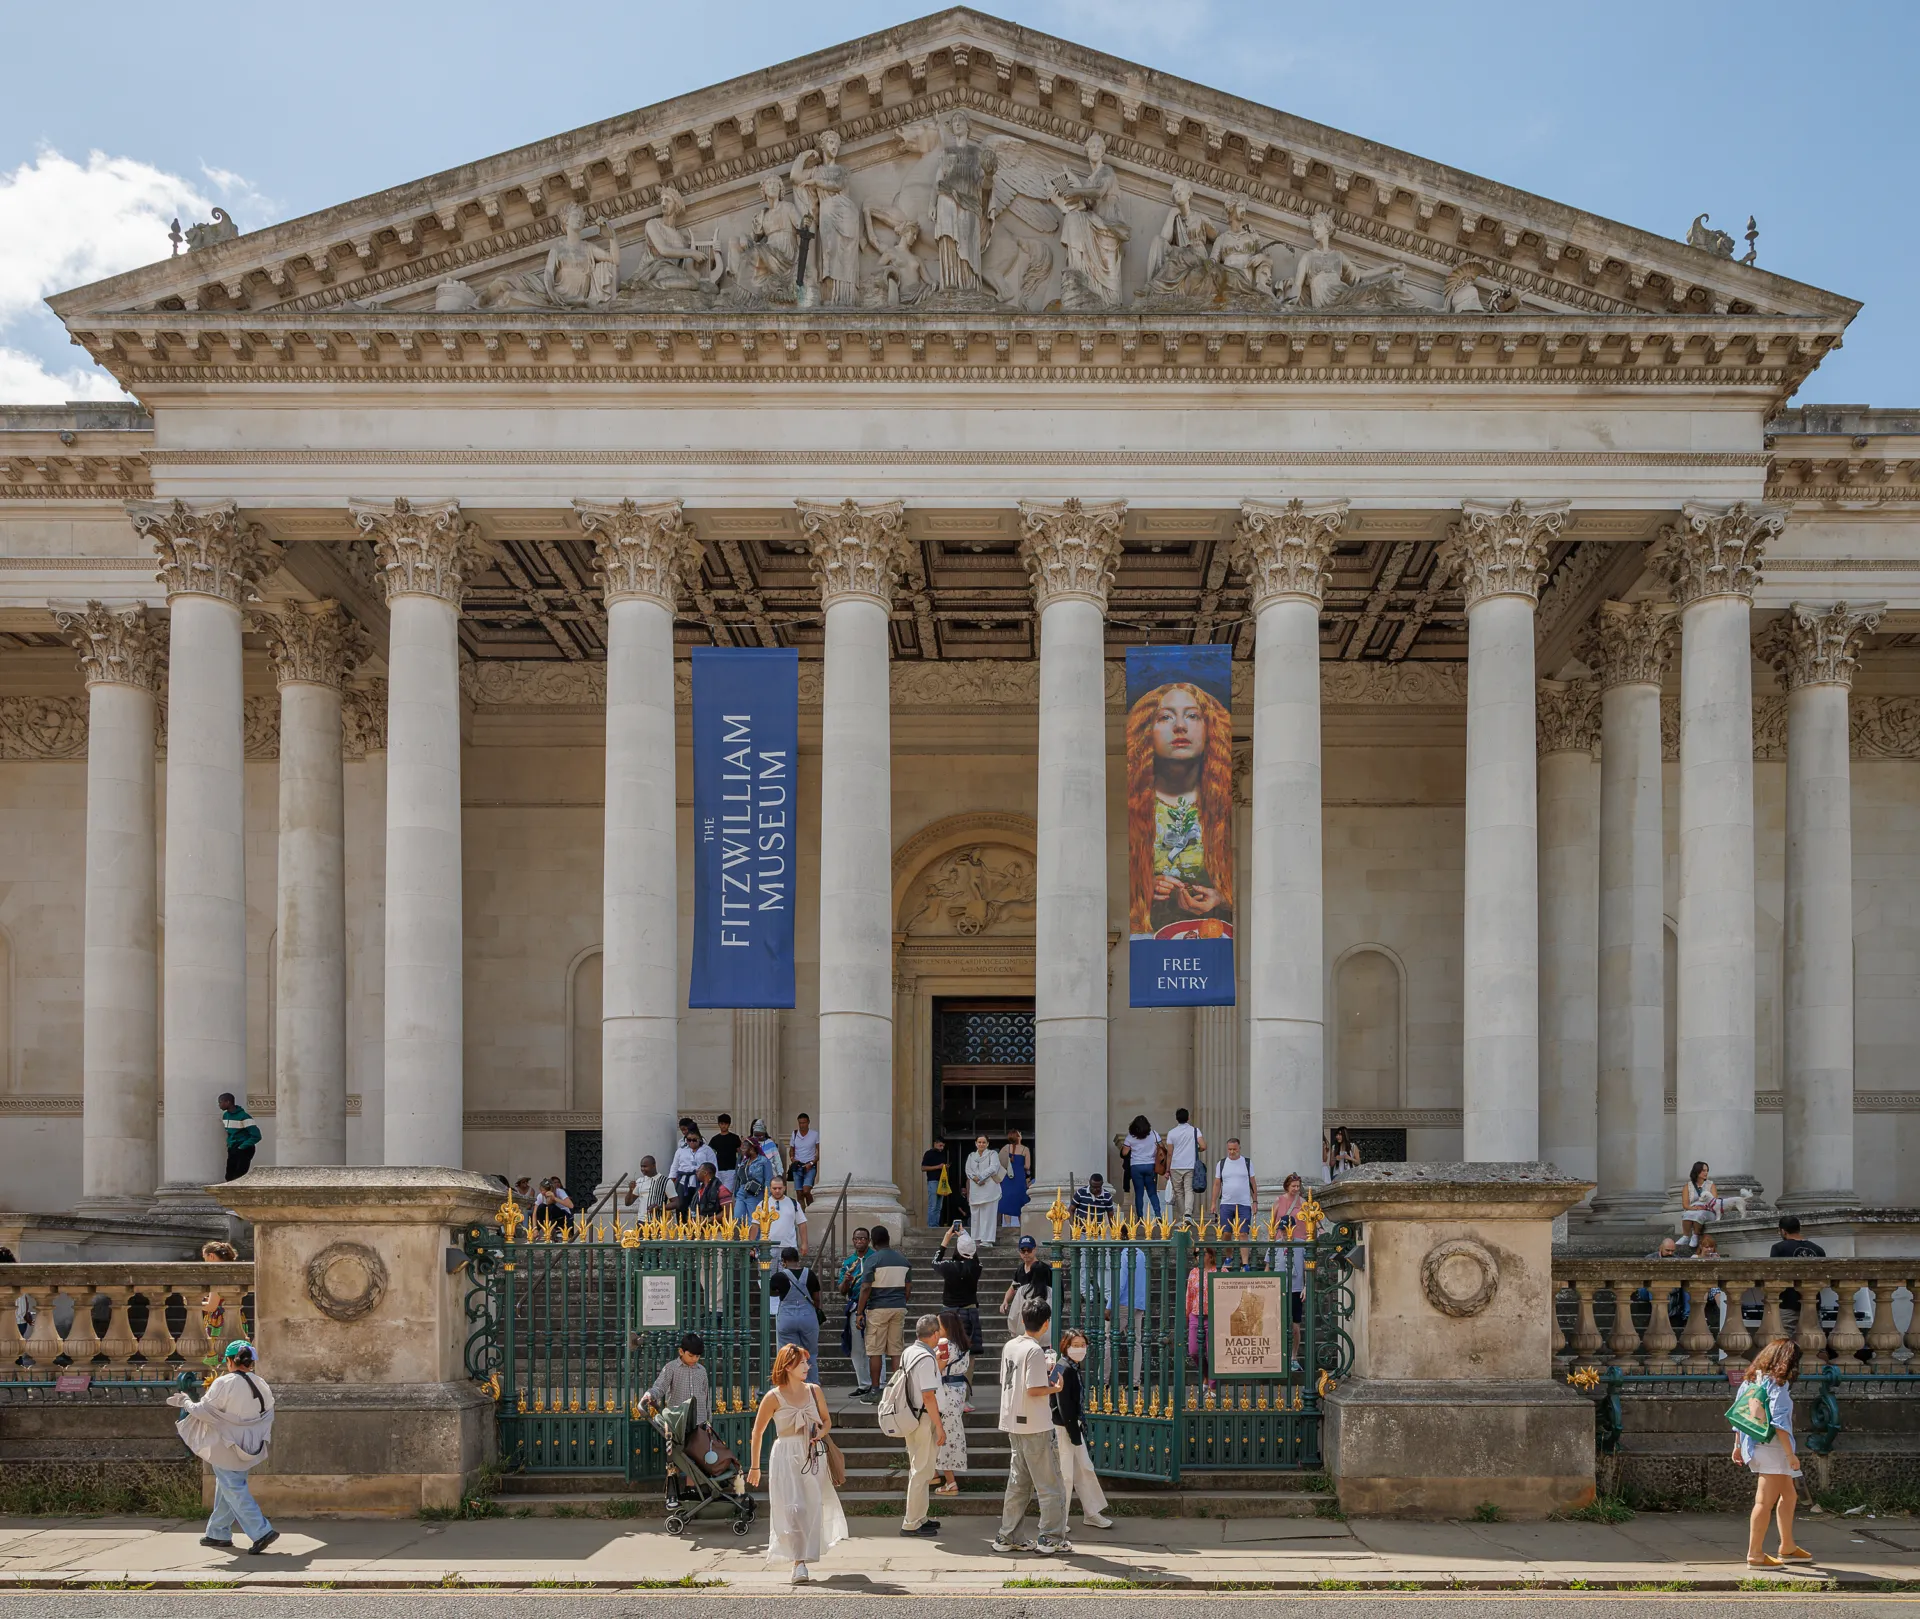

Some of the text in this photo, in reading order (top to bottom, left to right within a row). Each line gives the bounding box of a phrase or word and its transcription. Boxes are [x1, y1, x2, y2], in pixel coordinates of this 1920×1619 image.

[704, 816, 715, 843] THE
[721, 714, 751, 947] FITZWILLIAM
[758, 750, 787, 911] MUSEUM
[1163, 957, 1202, 971] FREE
[1157, 976, 1209, 990] ENTRY
[1225, 1337, 1270, 1347] MADE IN
[1225, 1346, 1271, 1356] ANCIENT
[1231, 1356, 1265, 1365] EGYPT
